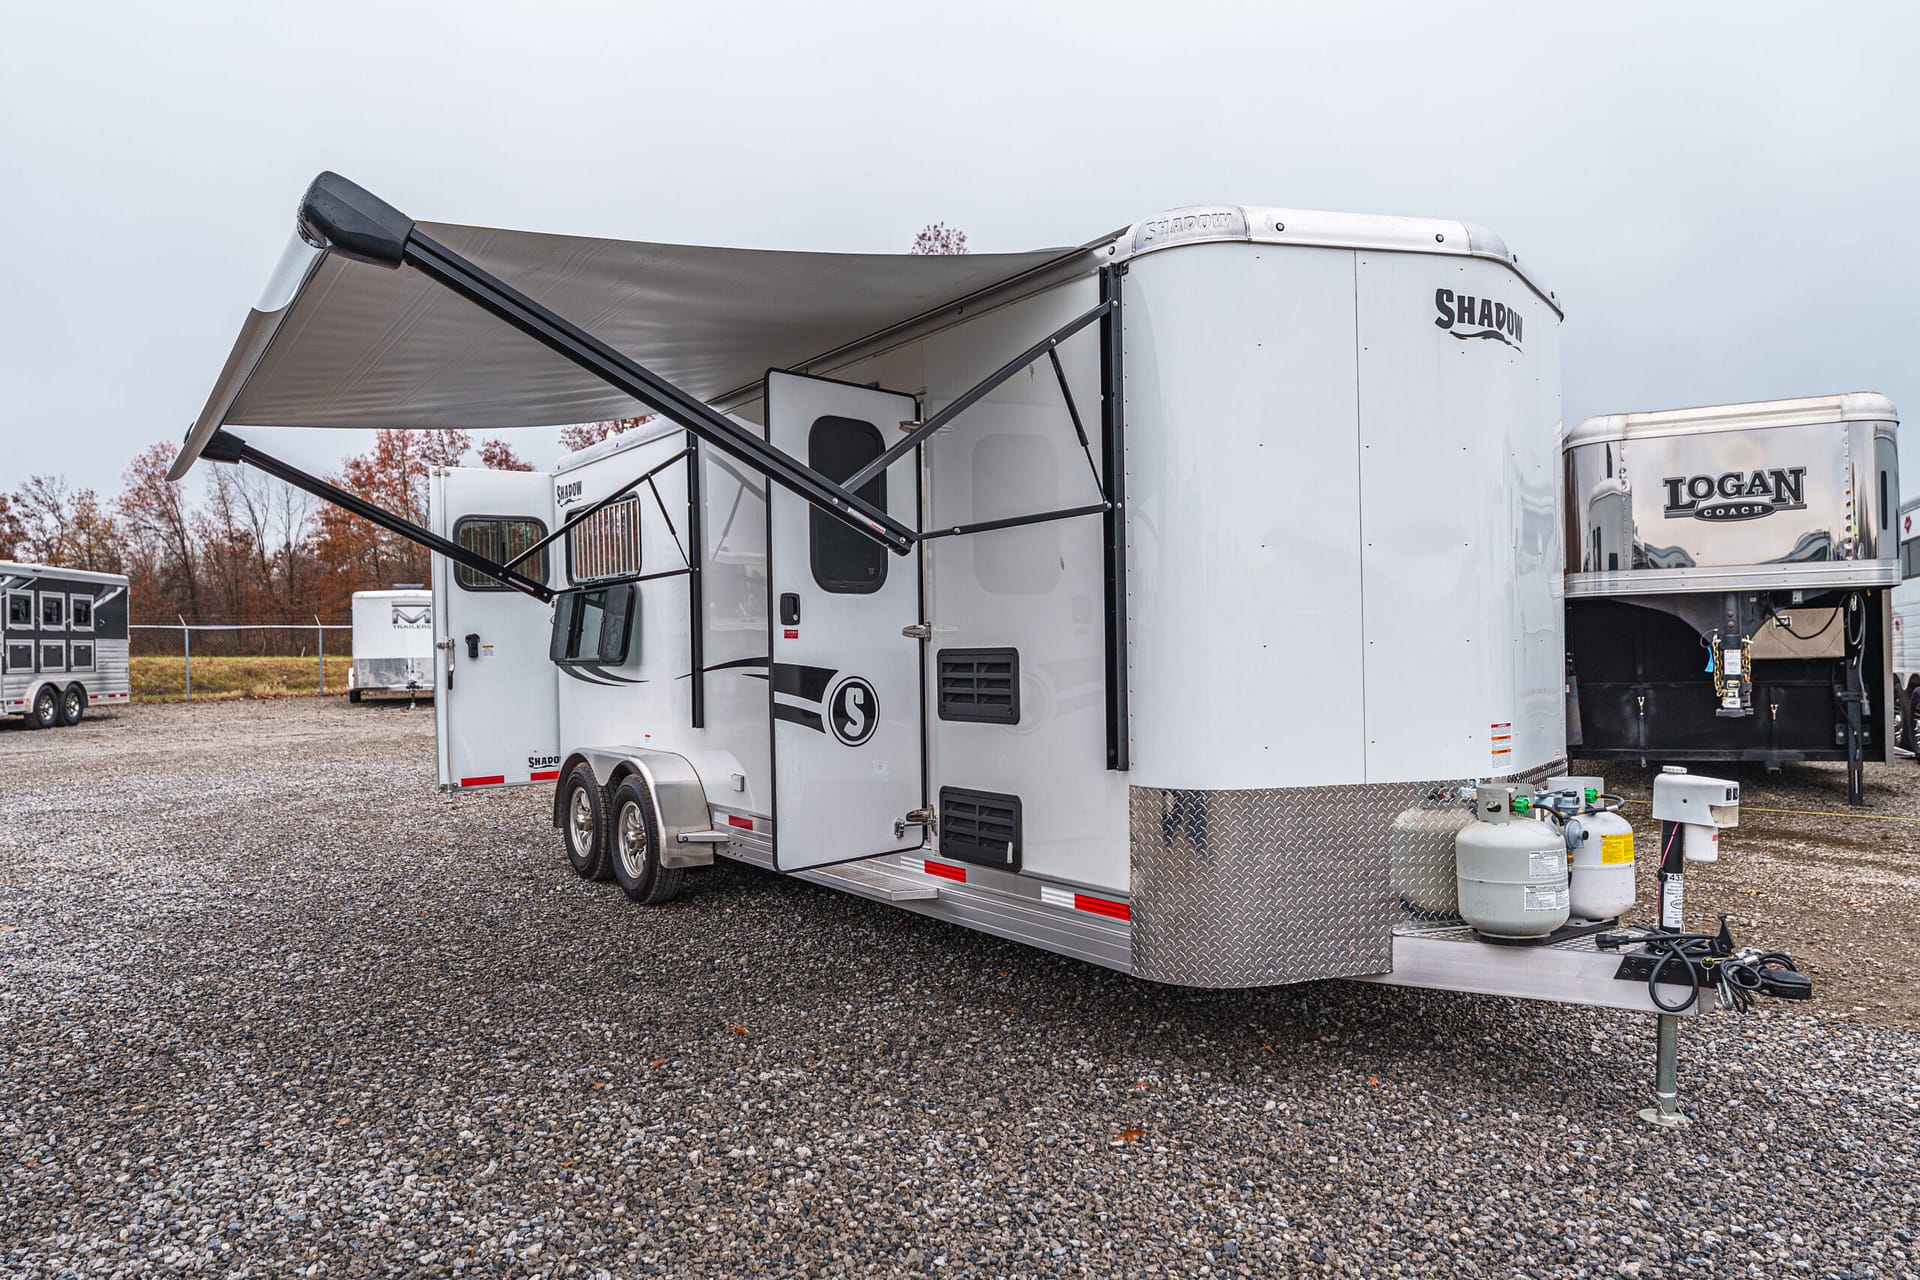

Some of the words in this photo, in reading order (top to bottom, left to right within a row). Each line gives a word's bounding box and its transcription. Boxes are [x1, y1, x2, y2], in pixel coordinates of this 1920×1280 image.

[1145, 213, 1232, 241] SHADOW
[1435, 288, 1523, 343] SHADOW
[557, 480, 582, 504] SHADOW
[1663, 467, 1806, 512] LOGAN
[1704, 505, 1763, 517] COACH
[528, 755, 561, 768] SHADO
